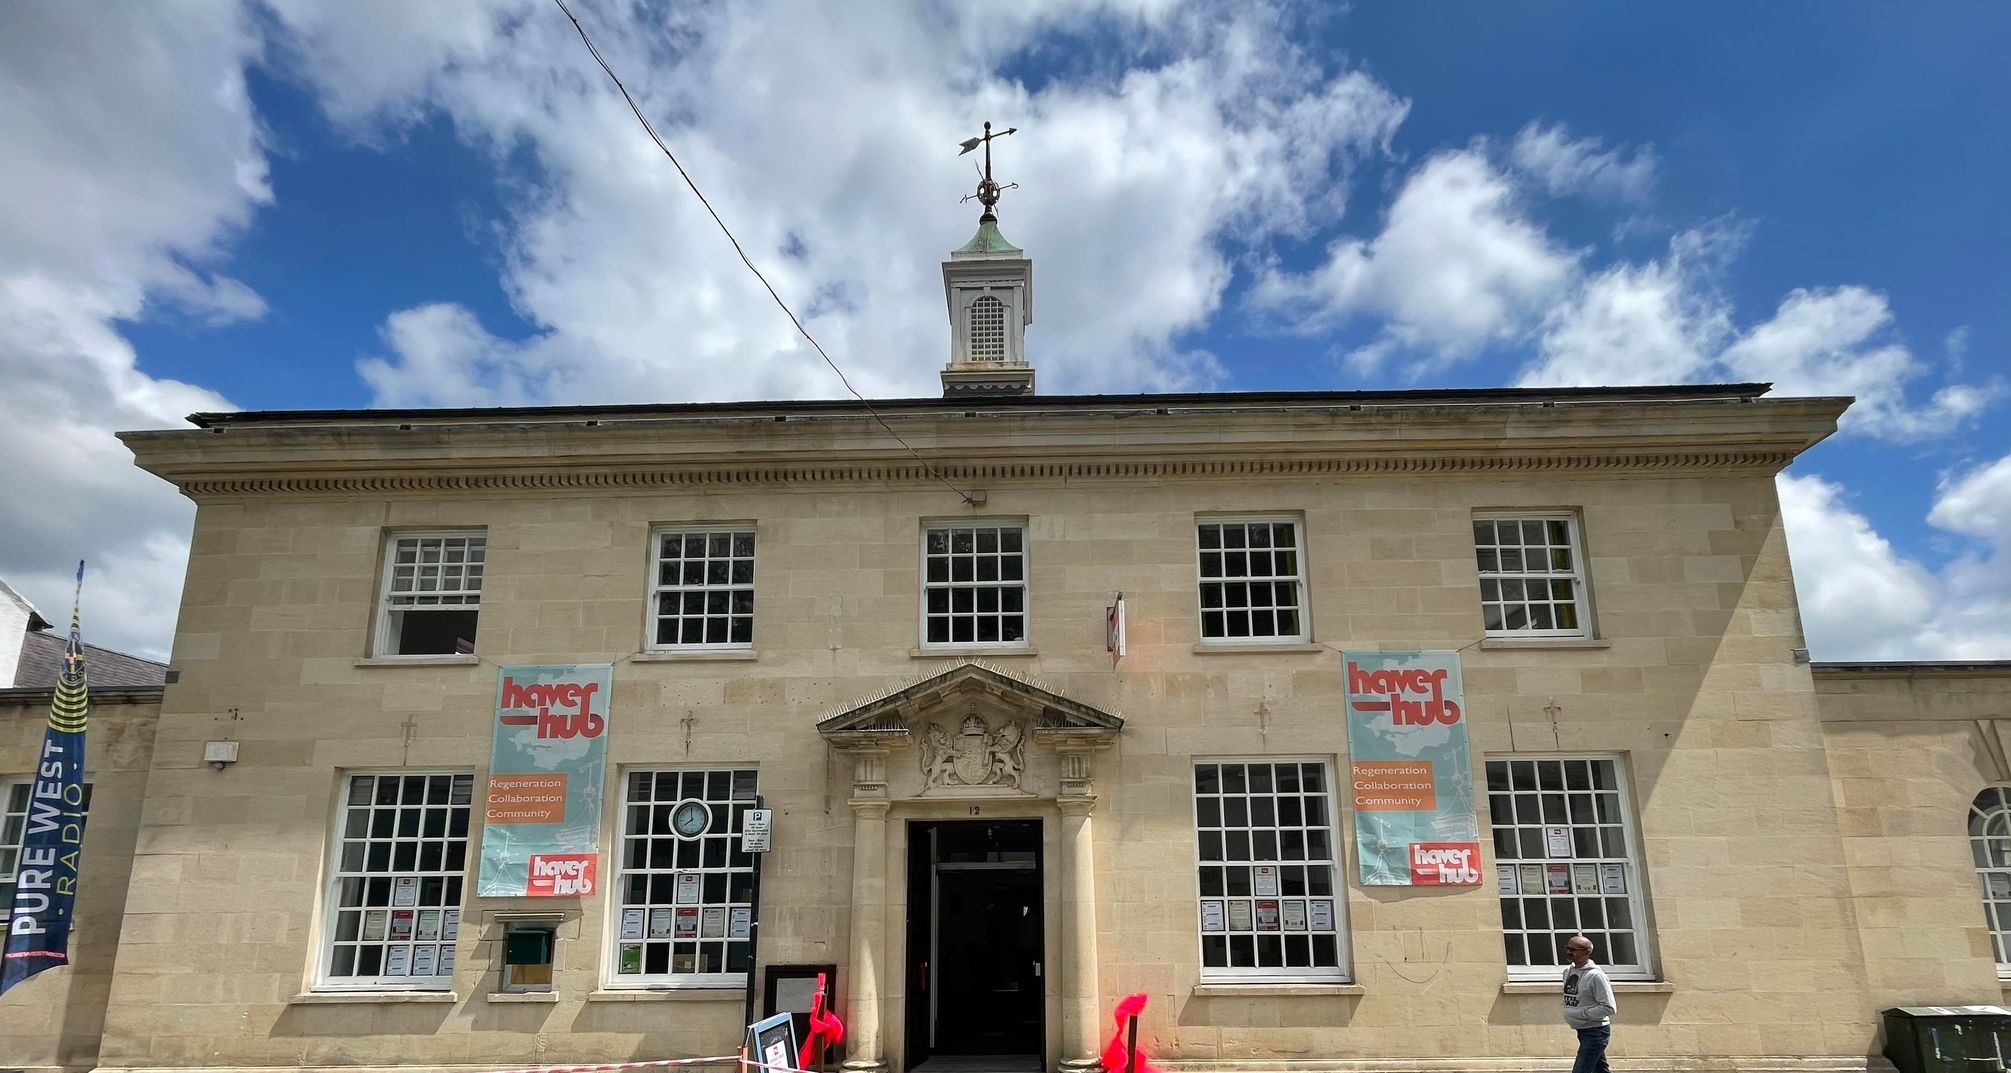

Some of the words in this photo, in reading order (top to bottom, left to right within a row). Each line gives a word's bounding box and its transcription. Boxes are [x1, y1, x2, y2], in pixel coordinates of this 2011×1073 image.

[1347, 661, 1448, 695] haver
[501, 676, 598, 709] haver
[1390, 693, 1462, 726] hub
[537, 707, 605, 739] hub
[1353, 765, 1427, 777] Regeneration
[28, 739, 66, 834] WEST
[489, 779, 562, 791] Regeneration
[1354, 781, 1432, 791] Collaboration
[488, 793, 563, 804] Collaboration
[1355, 796, 1422, 807] Community
[486, 809, 551, 820] Community
[969, 806, 980, 815] 12
[55, 782, 84, 897] RADIO
[1413, 844, 1471, 865] haver
[533, 856, 589, 877] haver
[1438, 863, 1479, 884] hub
[11, 846, 56, 936] PURE
[553, 874, 593, 896] hub
